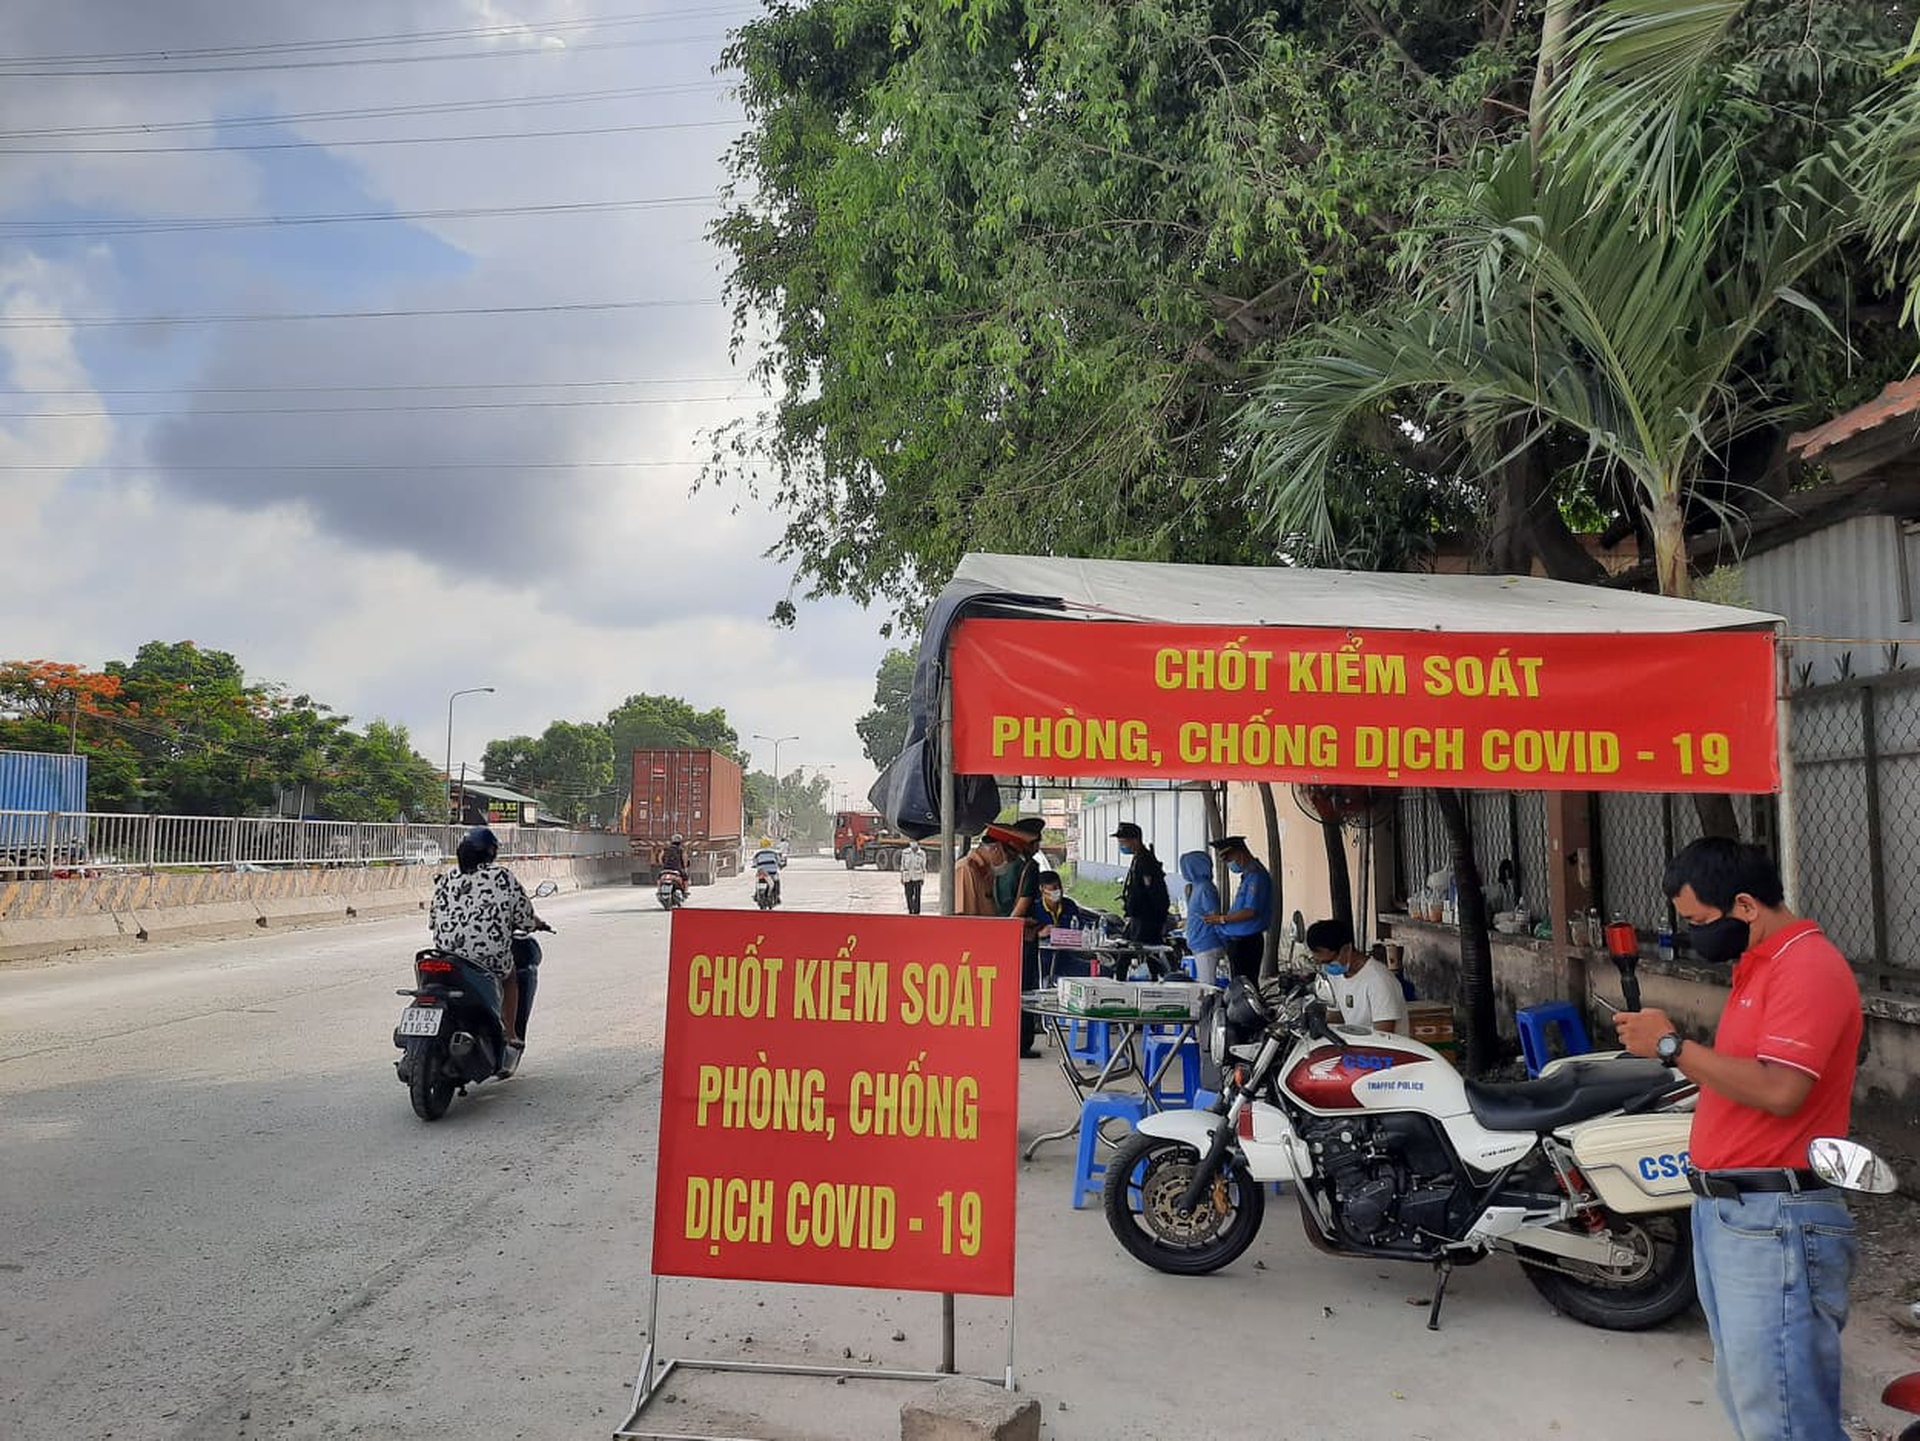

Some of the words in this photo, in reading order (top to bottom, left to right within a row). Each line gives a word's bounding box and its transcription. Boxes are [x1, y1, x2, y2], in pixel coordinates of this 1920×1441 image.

[1154, 635, 1274, 691] CHỐT
[1288, 636, 1407, 695] KIỂM
[1423, 646, 1544, 698] SOÁT
[992, 706, 1162, 767] PHÒNG,
[1179, 707, 1338, 767] CHỐNG
[1354, 726, 1465, 779] DỊCH
[1481, 728, 1620, 774] COVID
[1637, 751, 1655, 761] -
[1672, 732, 1730, 776] 19
[688, 935, 784, 1018] CHỐT
[793, 934, 889, 1023] KIỂM
[901, 952, 998, 1028] SOÁT
[697, 1051, 836, 1140] PHÒNG,
[849, 1051, 979, 1140] CHỐNG
[1342, 1054, 1394, 1070] CSGT
[1367, 1081, 1395, 1091] TRAFFIC
[1397, 1081, 1424, 1091] POLICE
[685, 1176, 774, 1256] DỊCH
[786, 1181, 896, 1250] COVID
[909, 1217, 923, 1231] -
[938, 1191, 982, 1256] 19
